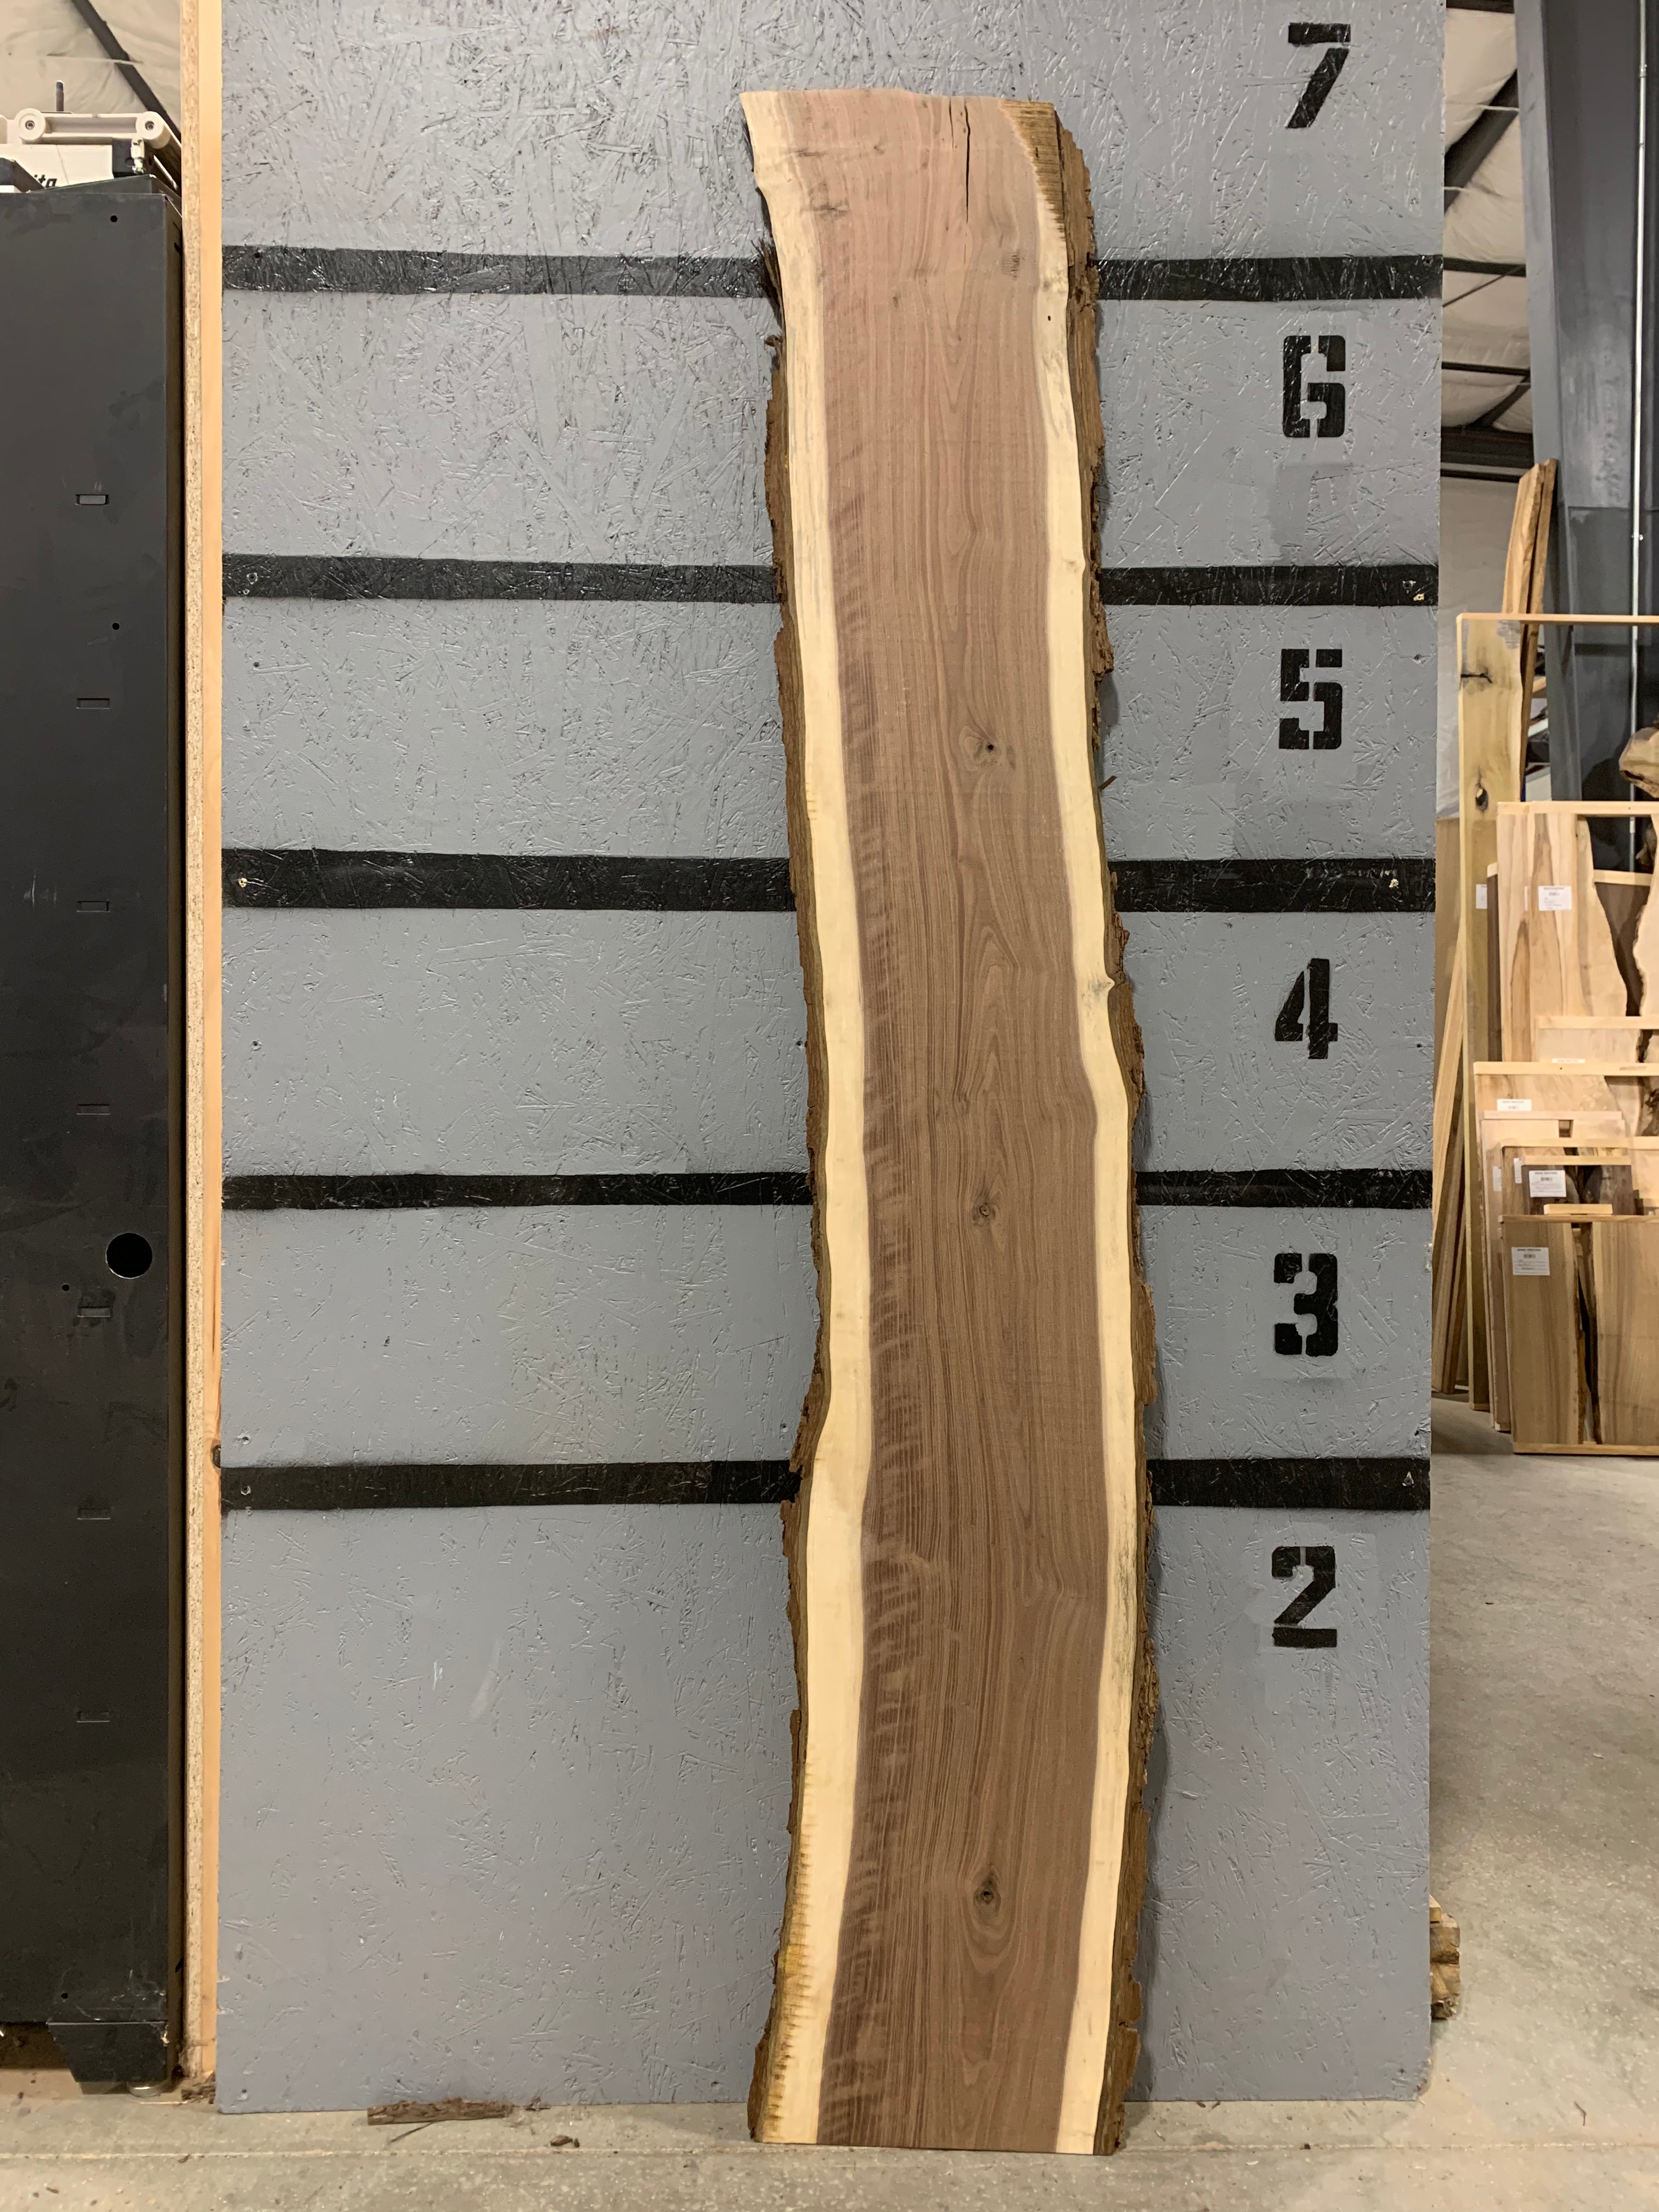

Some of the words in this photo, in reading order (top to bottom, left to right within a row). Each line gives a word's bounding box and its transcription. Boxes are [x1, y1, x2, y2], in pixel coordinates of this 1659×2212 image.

[1288, 24, 1350, 128] 7
[1283, 335, 1345, 438] 6
[1279, 649, 1342, 749] 5
[1274, 958, 1338, 1059] 4
[1274, 1252, 1338, 1357] 3
[1272, 1546, 1337, 1649] 2
